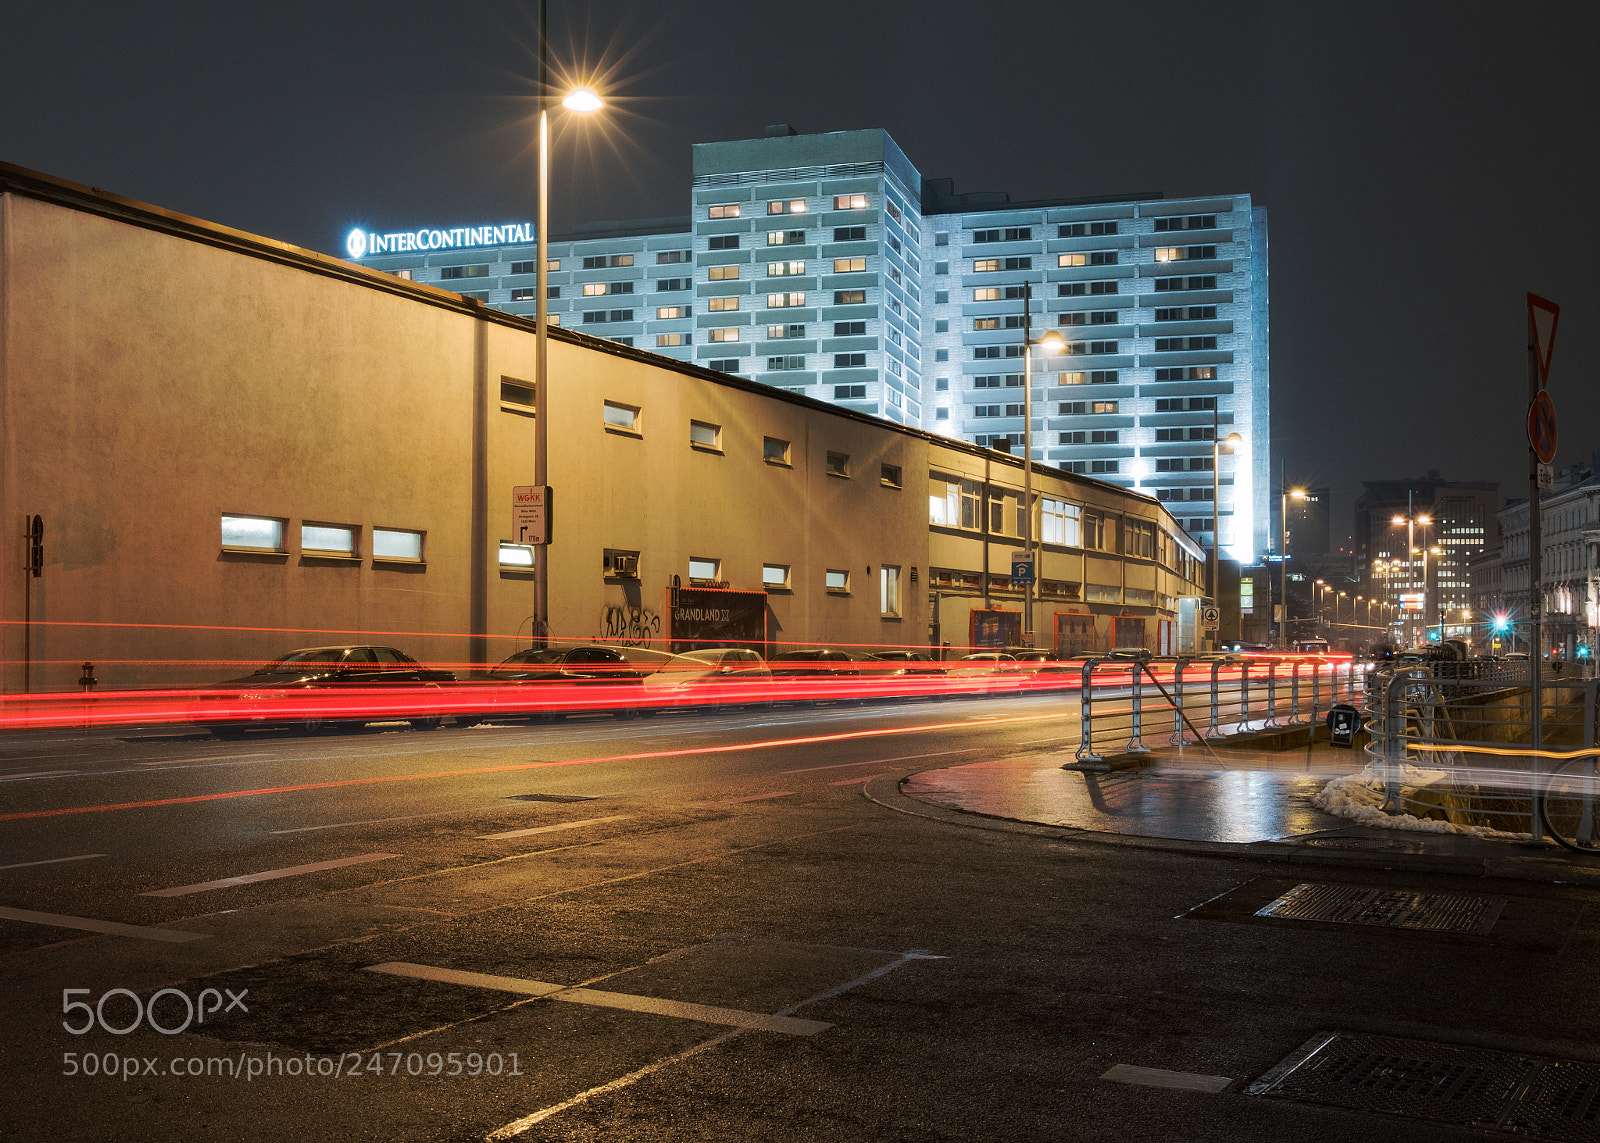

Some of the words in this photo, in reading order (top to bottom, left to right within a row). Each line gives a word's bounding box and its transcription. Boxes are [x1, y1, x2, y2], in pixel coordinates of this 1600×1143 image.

[369, 223, 534, 254] INTERCONTINENTAL
[517, 488, 541, 502] WGKK
[674, 608, 720, 621] GRANDLAND
